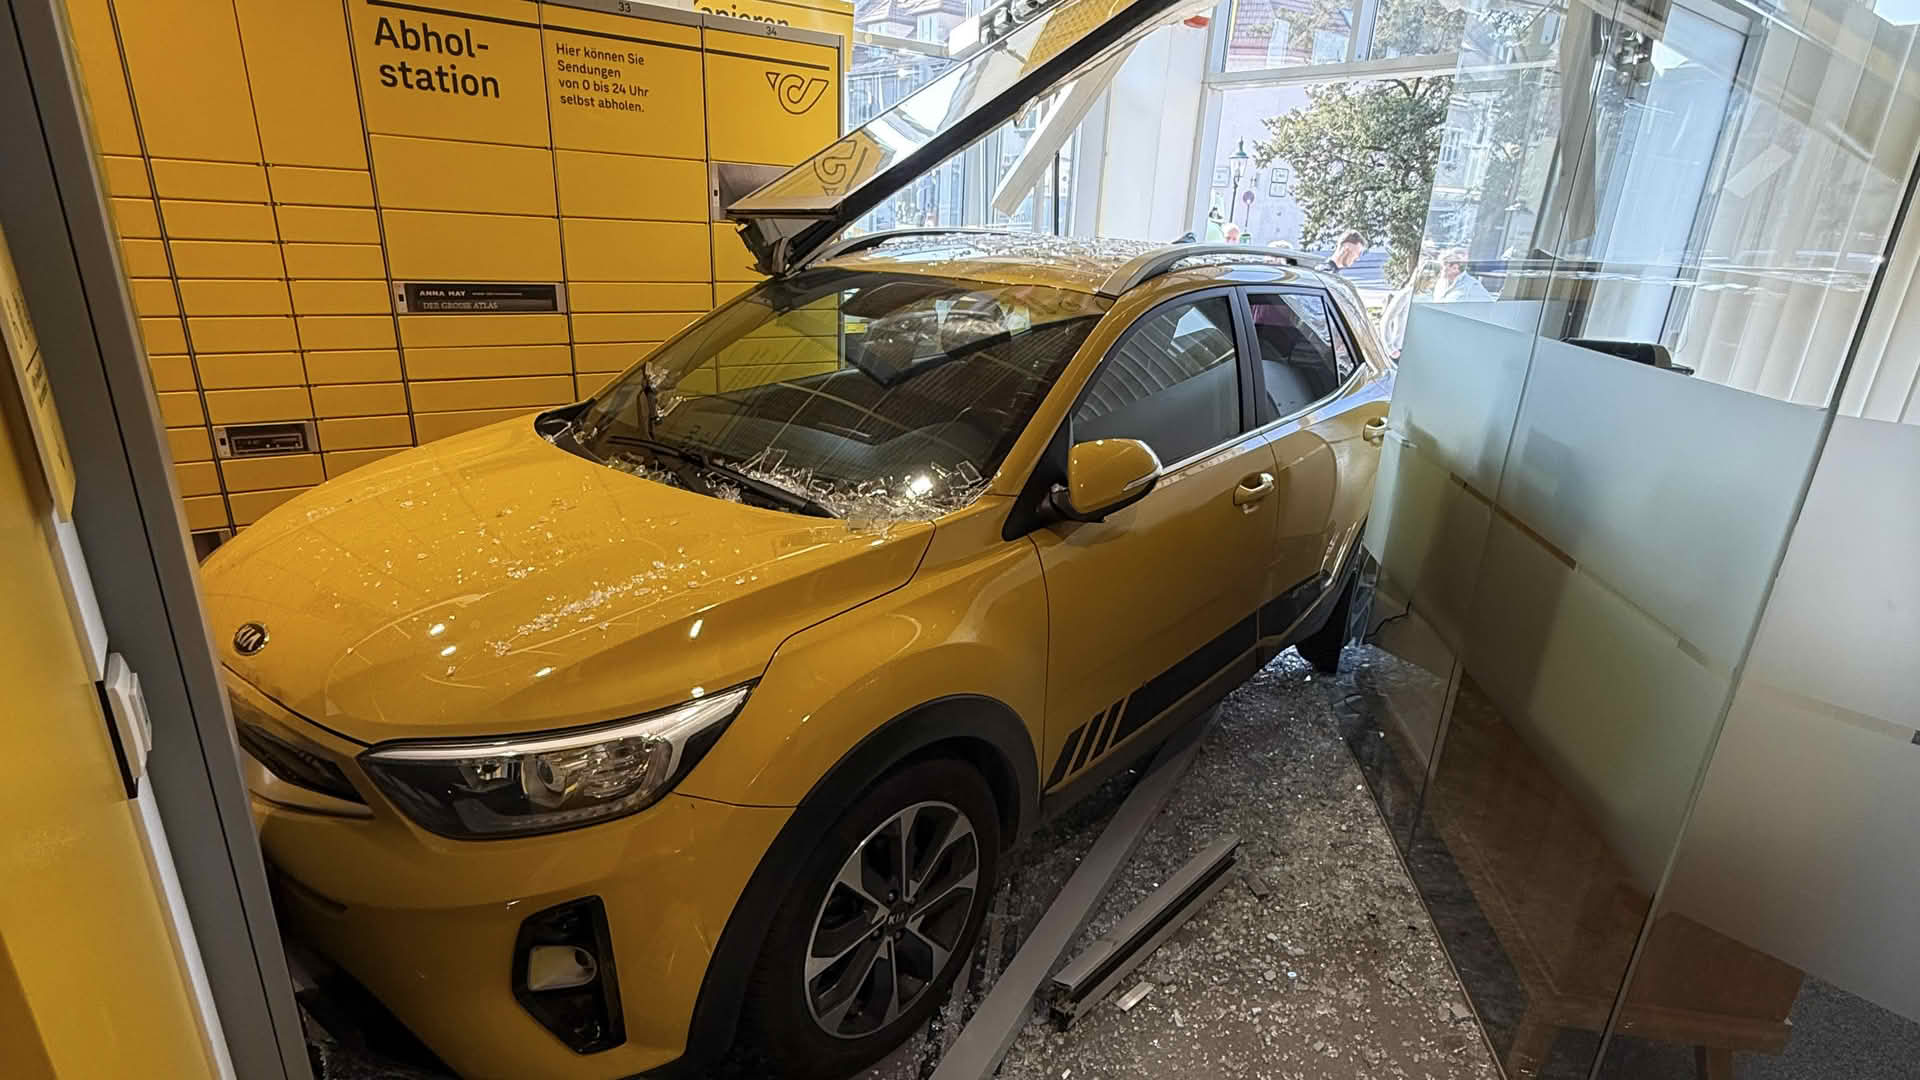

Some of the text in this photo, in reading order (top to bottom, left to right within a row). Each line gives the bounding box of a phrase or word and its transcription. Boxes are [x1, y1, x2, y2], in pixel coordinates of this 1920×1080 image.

[618, 1, 632, 13] 33
[374, 16, 489, 58] Abhol-
[765, 25, 777, 36] 34
[556, 43, 645, 66] Hier können Sie
[557, 60, 621, 79] Sendungen
[379, 61, 500, 99] station
[558, 79, 580, 89] von
[593, 80, 610, 93] bis
[612, 83, 626, 95] 24
[629, 84, 649, 97] Uhr
[560, 94, 645, 113] selbst abholen.
[236, 625, 261, 650] KIA
